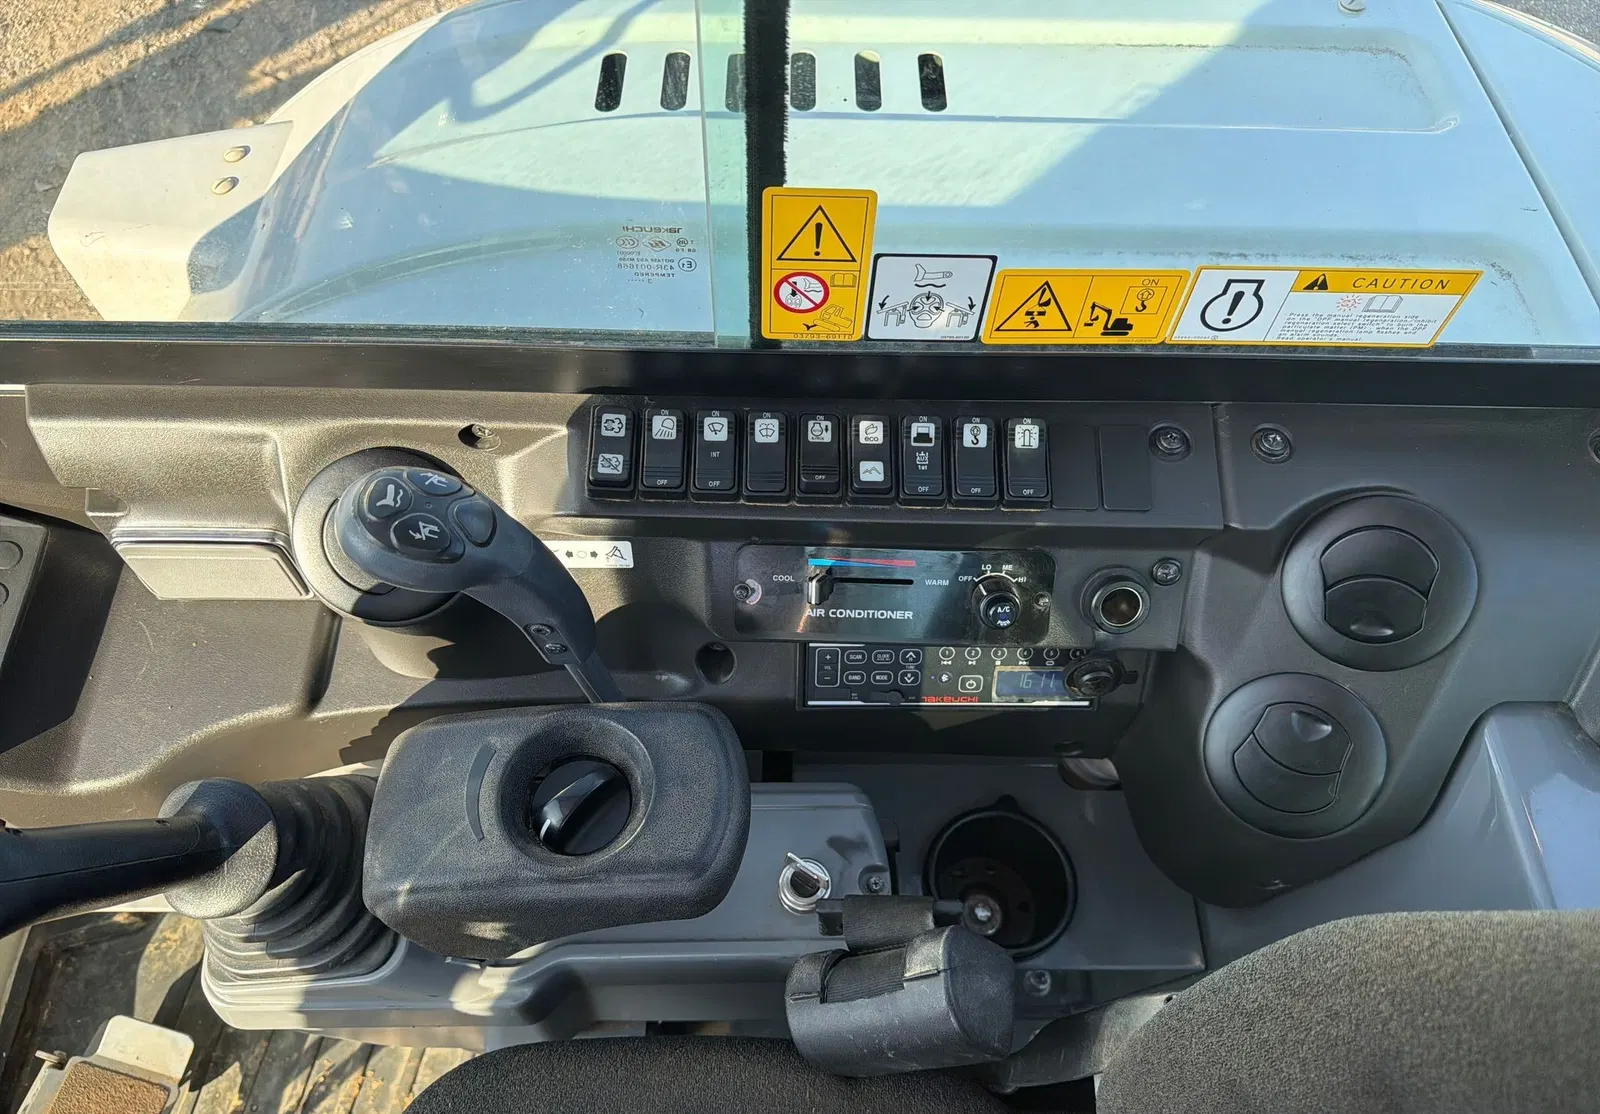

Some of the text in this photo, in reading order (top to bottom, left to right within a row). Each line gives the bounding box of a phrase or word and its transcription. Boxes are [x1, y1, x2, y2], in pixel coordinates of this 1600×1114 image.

[1141, 278, 1160, 286] ON
[1352, 277, 1451, 290] CAUTION
[772, 574, 795, 582] COOL
[924, 579, 949, 587] WARM
[805, 607, 914, 620] AIR CONDITIONER
[921, 695, 980, 703] TAKEUCHI
